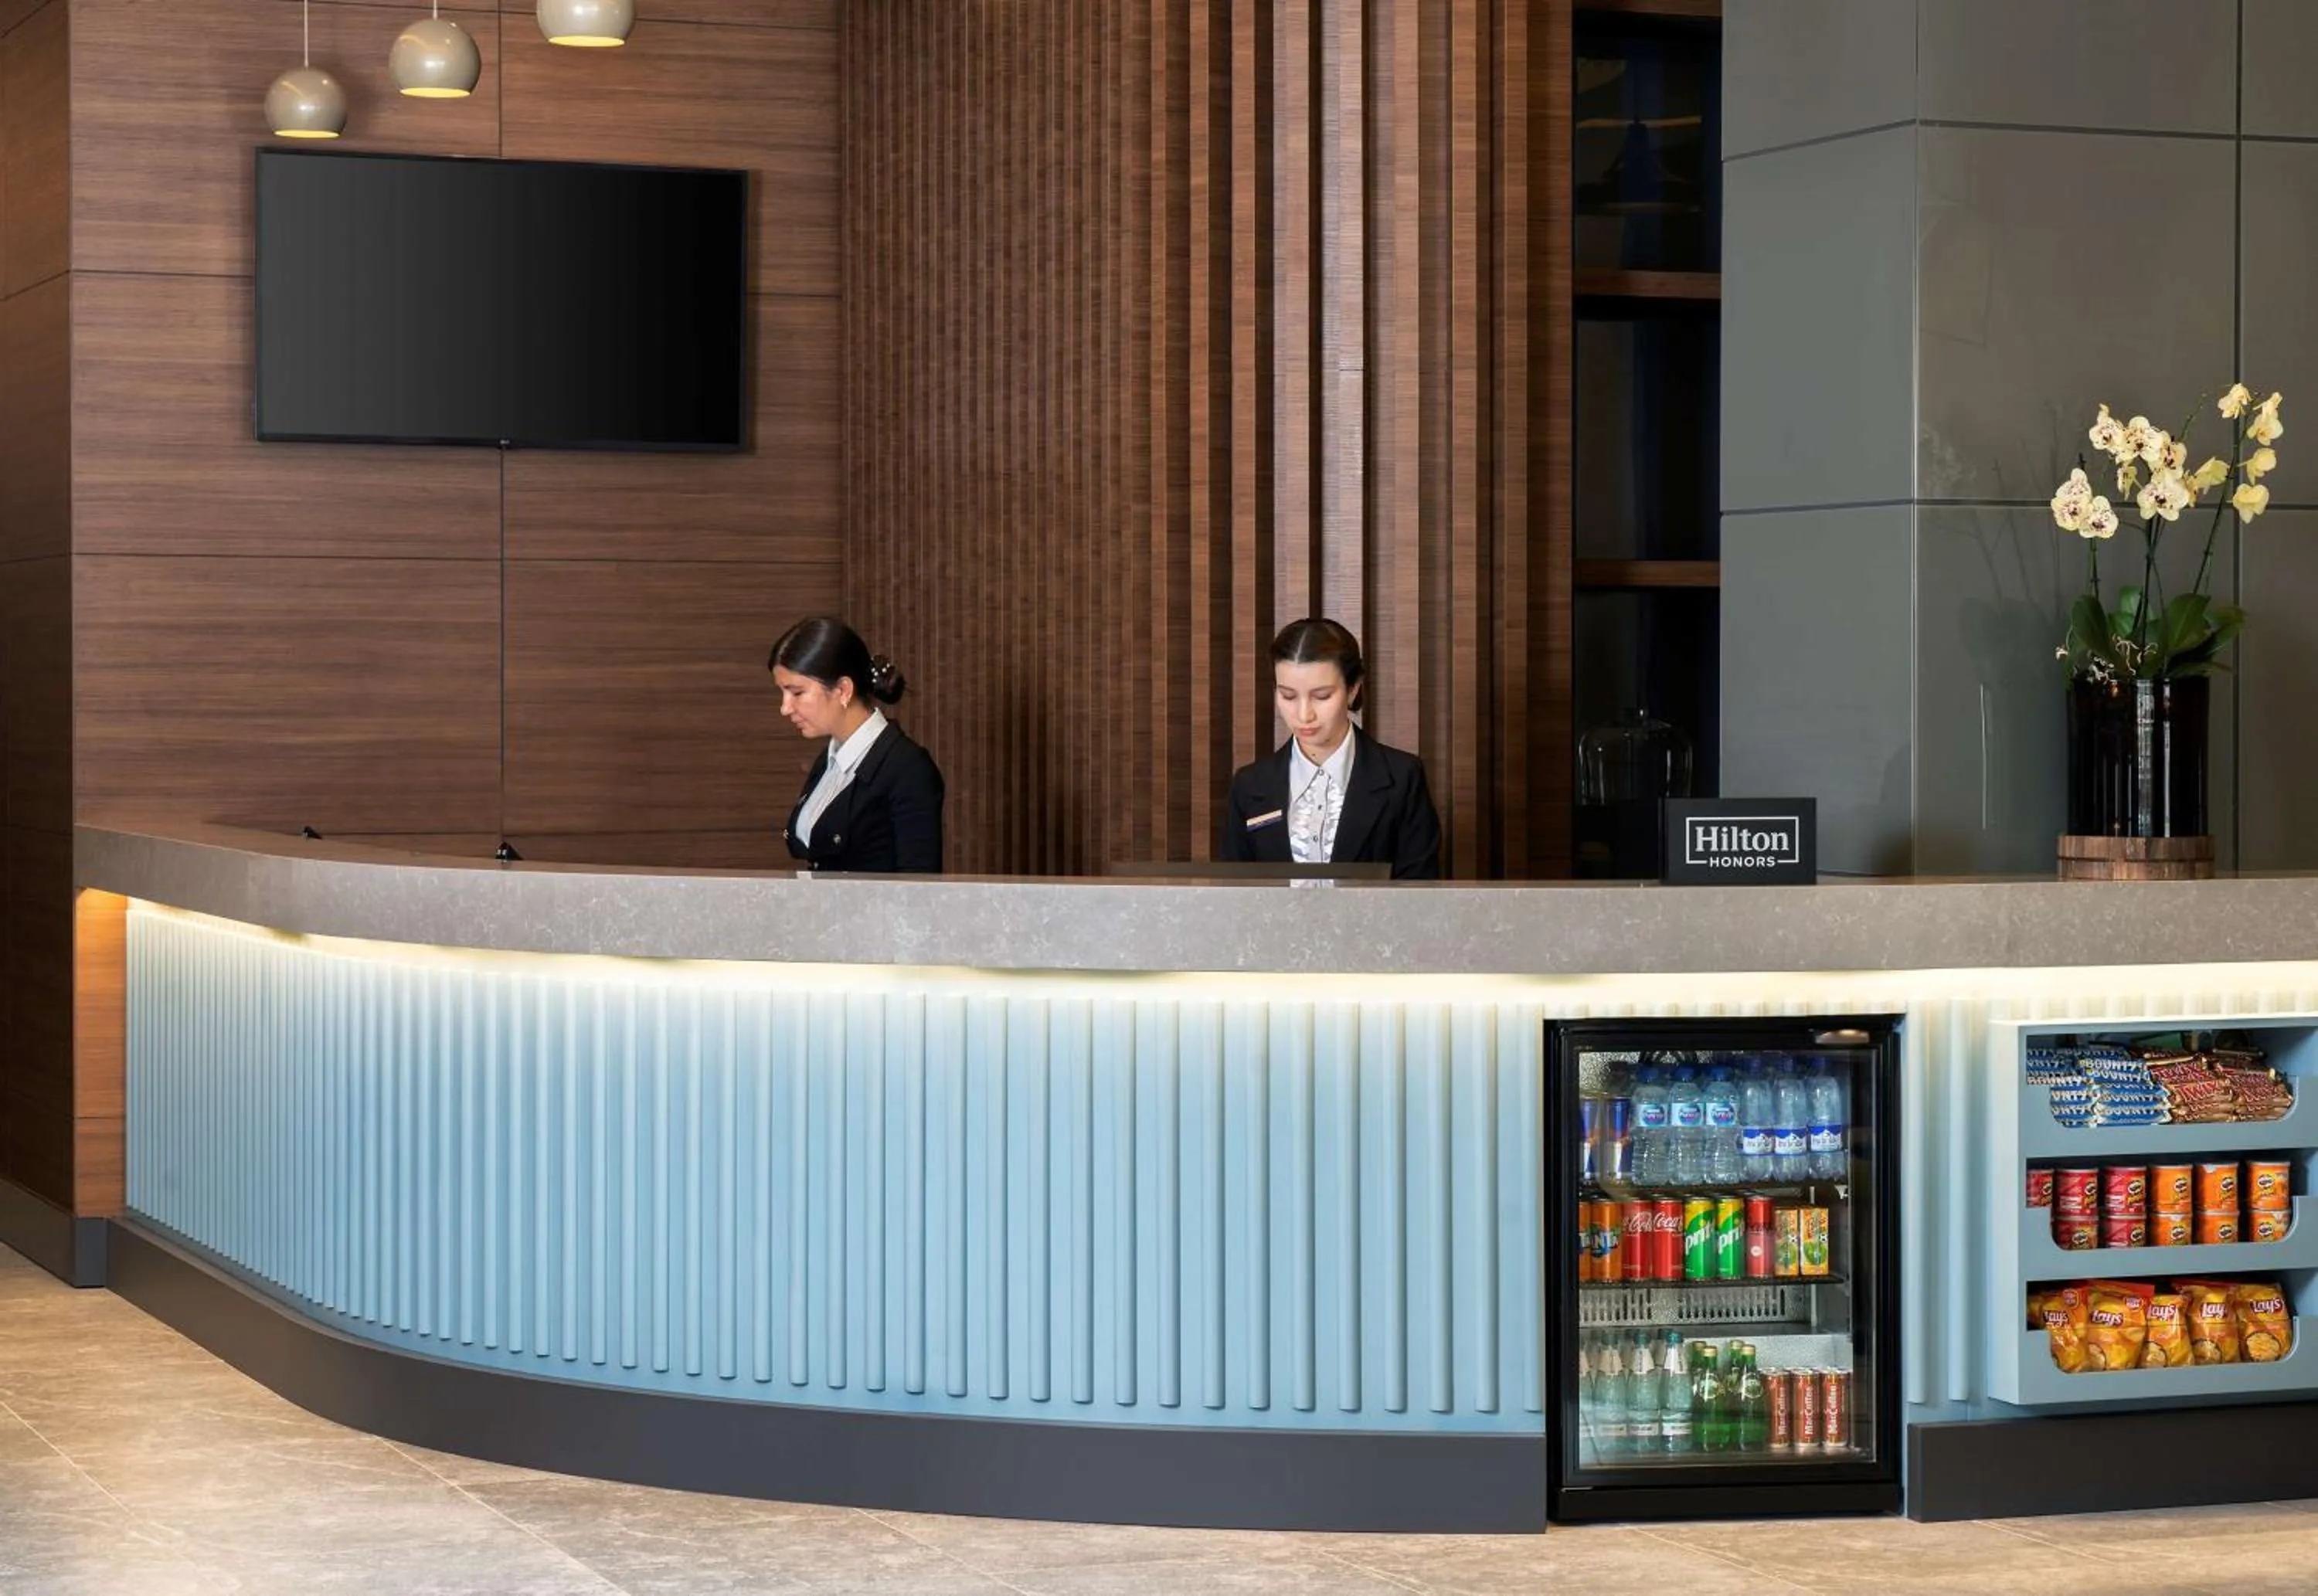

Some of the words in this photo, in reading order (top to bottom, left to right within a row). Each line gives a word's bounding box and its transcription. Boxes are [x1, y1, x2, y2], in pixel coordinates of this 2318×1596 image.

[1695, 826, 1789, 852] Hilton
[1709, 856, 1776, 868] HONORS
[2086, 1058, 2136, 1071] BOUNTY
[2051, 1090, 2087, 1102] UNTY
[2051, 1105, 2085, 1116] UNTY
